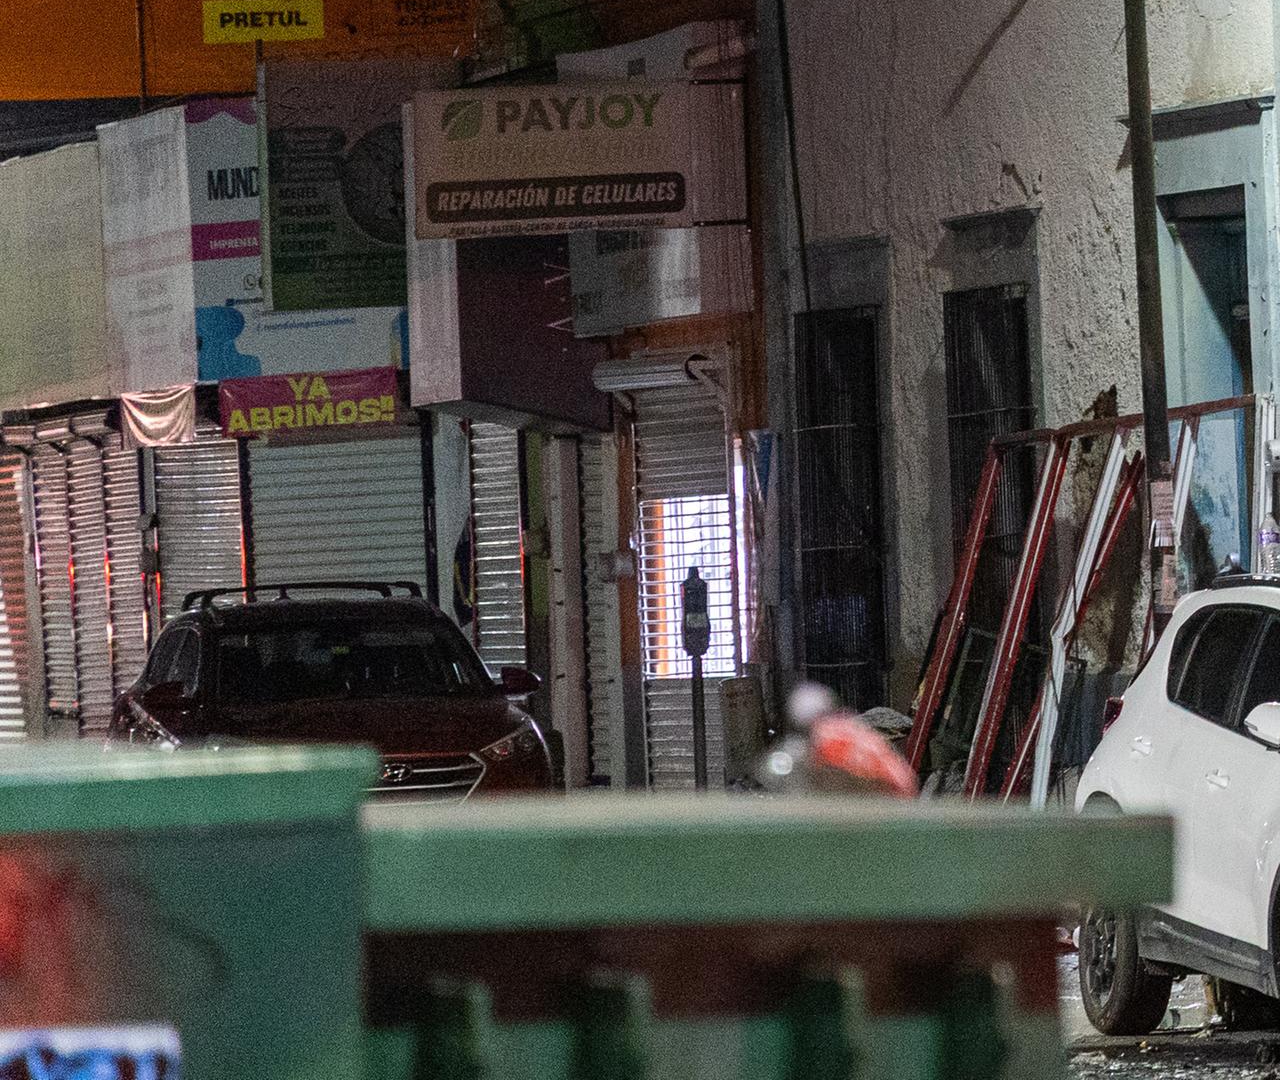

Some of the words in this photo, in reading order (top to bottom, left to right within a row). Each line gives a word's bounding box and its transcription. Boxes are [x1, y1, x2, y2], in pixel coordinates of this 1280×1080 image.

[219, 10, 309, 29] PRETUL
[496, 92, 664, 133] PAYJOY
[207, 167, 261, 201] MUND
[437, 182, 550, 211] REPARACIÓN
[552, 186, 577, 206] DE
[581, 180, 678, 205] CELULARES
[209, 236, 259, 250] IMPRENTA
[287, 377, 332, 401] YA
[228, 394, 396, 434] ABRIMOS!!
